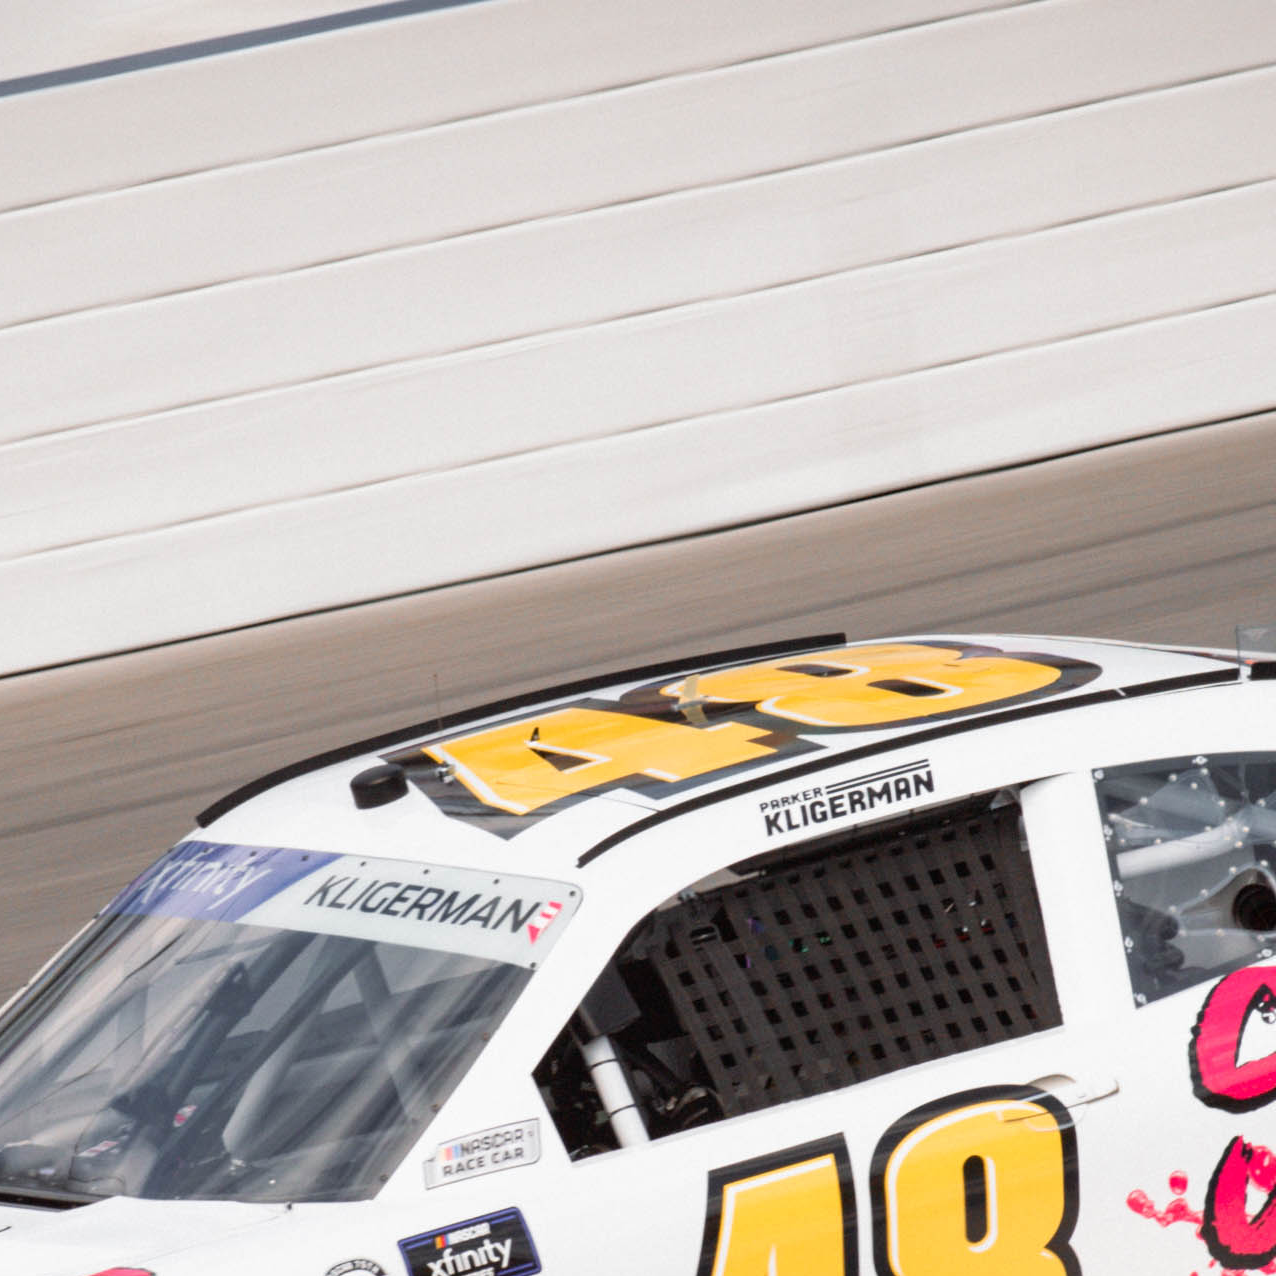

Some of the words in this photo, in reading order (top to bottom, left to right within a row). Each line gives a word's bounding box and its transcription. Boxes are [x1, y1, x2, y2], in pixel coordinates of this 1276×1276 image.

[380, 641, 1102, 838] 48
[759, 787, 823, 813] PARKER
[764, 770, 935, 837] KLIGERMAN
[303, 875, 541, 934] KLIGERMAN
[442, 1156, 486, 1177] RACE
[491, 1147, 524, 1174] CAR
[460, 1128, 525, 1157] NASCAR
